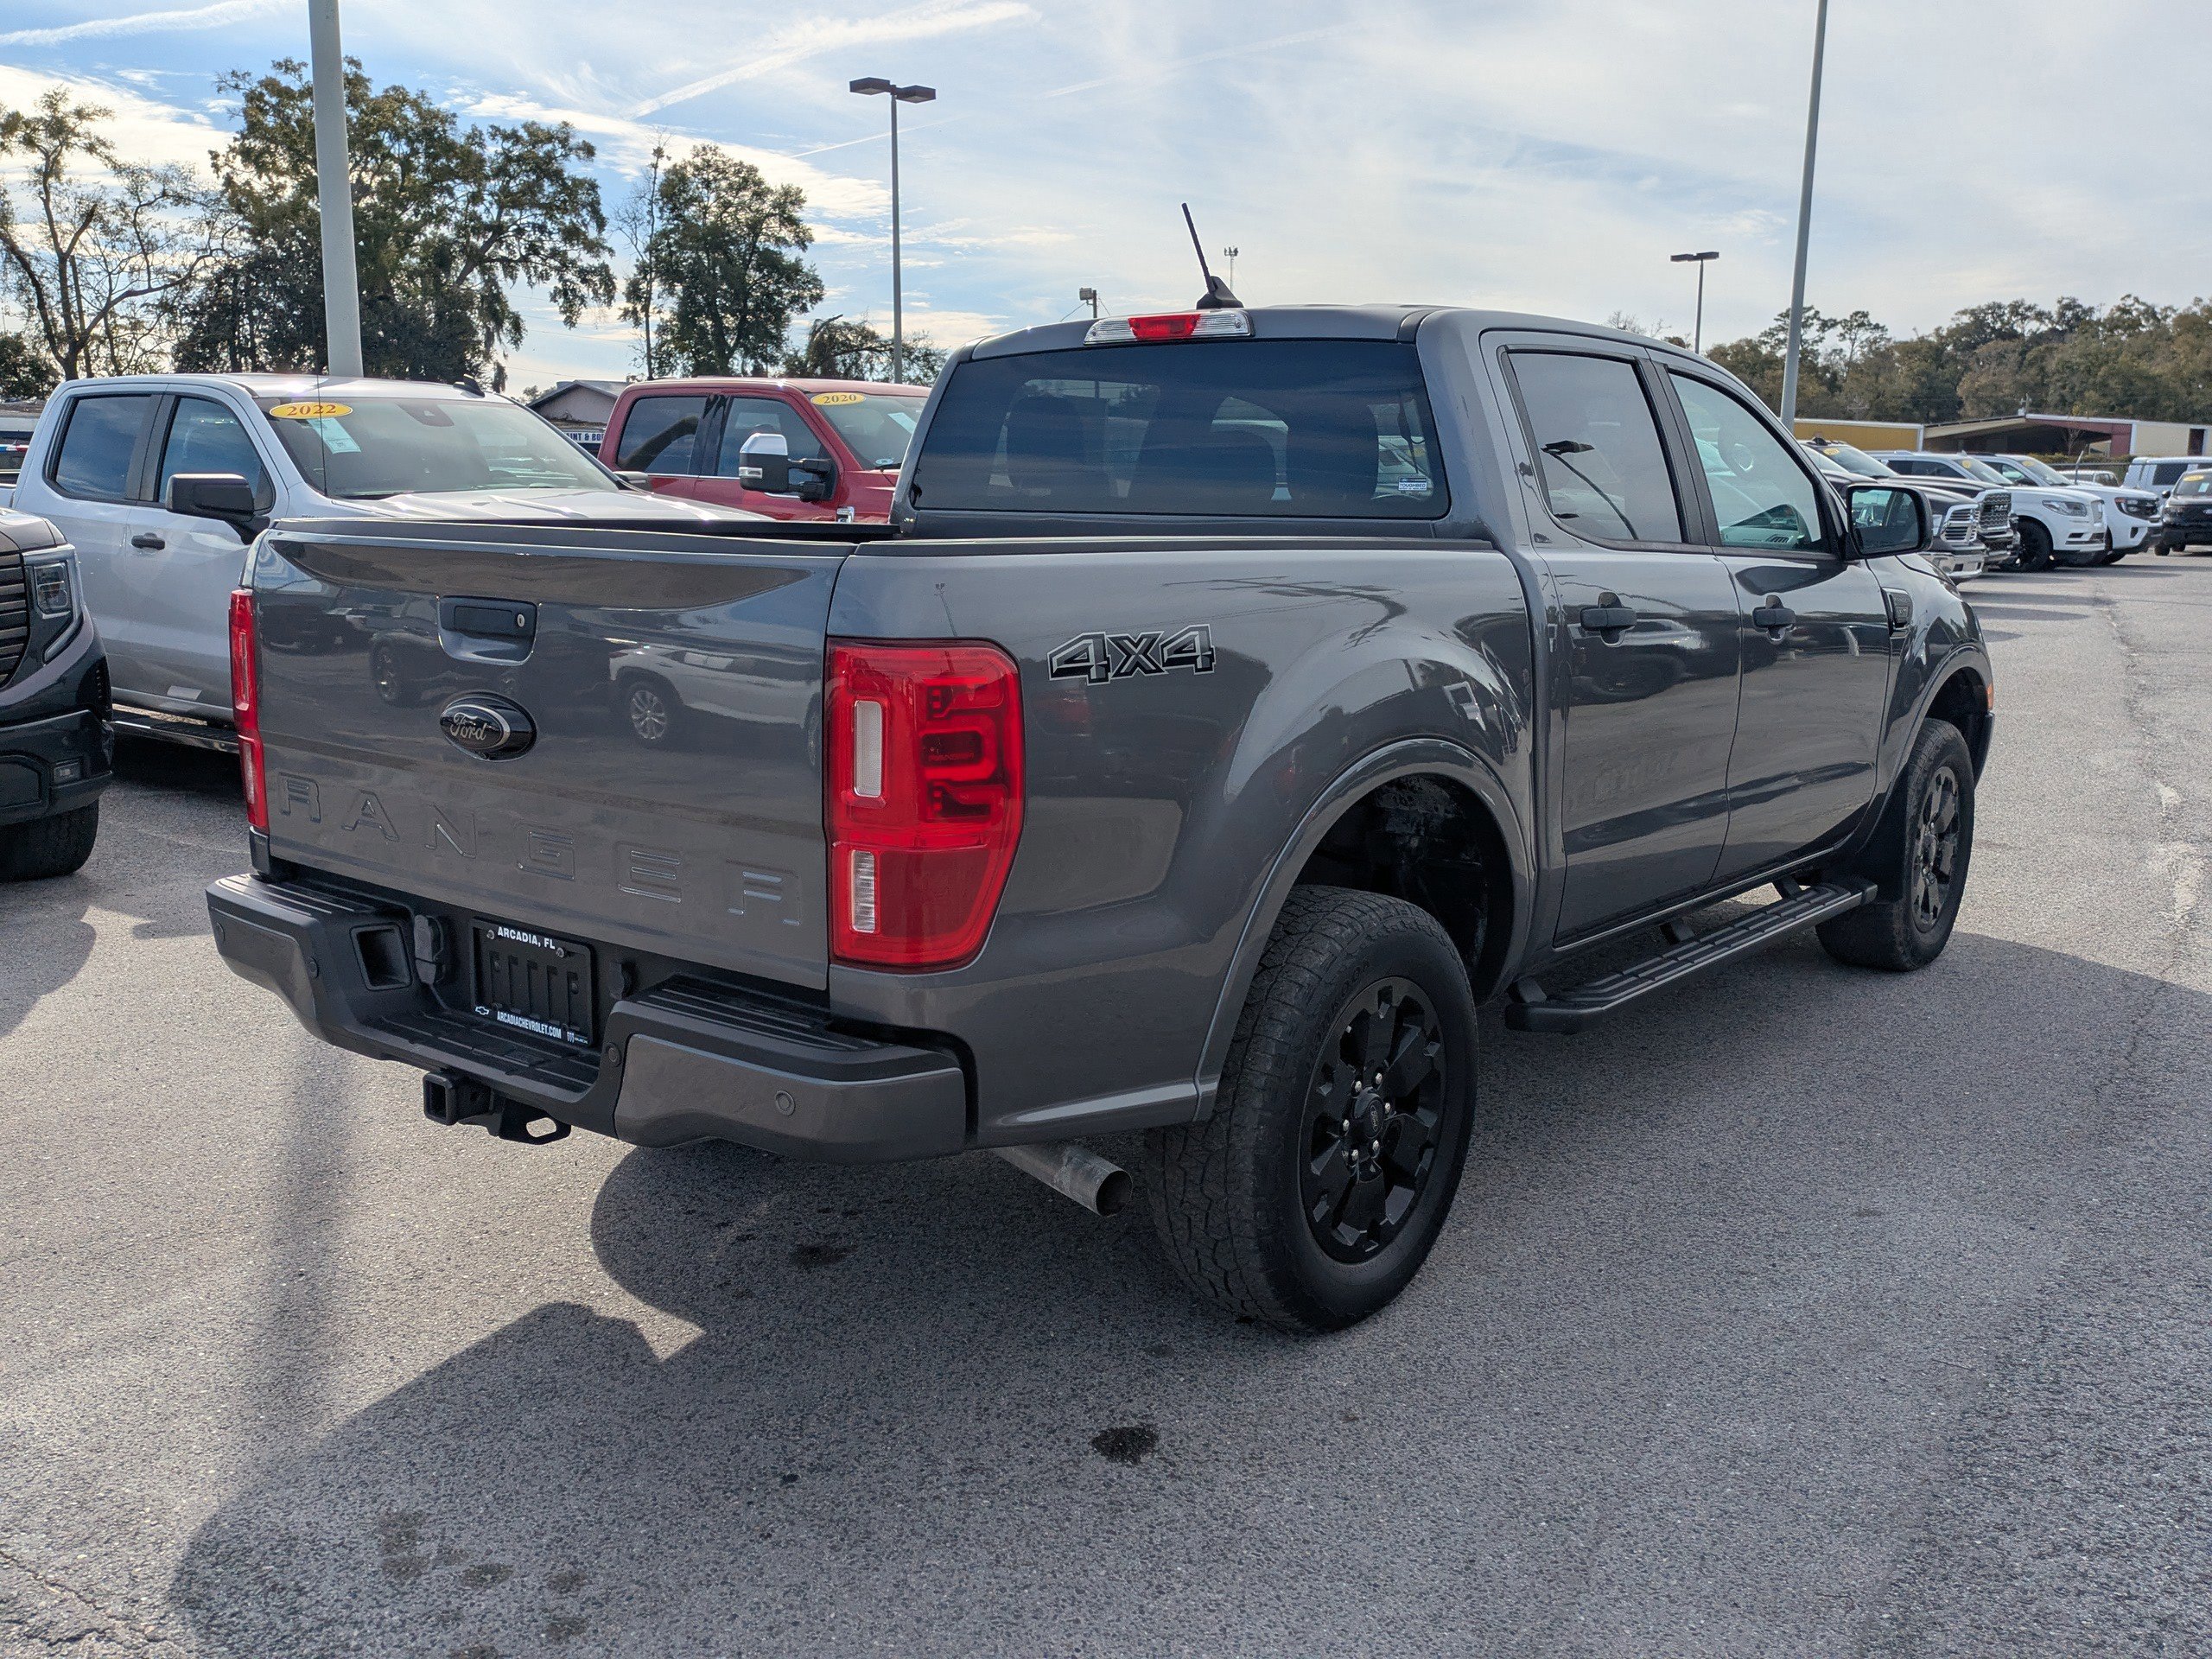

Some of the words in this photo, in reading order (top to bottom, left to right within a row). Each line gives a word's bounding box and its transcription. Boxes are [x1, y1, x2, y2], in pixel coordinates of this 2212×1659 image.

[286, 404, 337, 416] 2022
[823, 394, 857, 404] 2020
[449, 711, 489, 741] Ford
[278, 772, 802, 927] RANGER
[497, 926, 542, 948] ARCADIA,
[543, 937, 556, 950] FL
[497, 1011, 562, 1039] ARCADIACHEVROLET.COM
